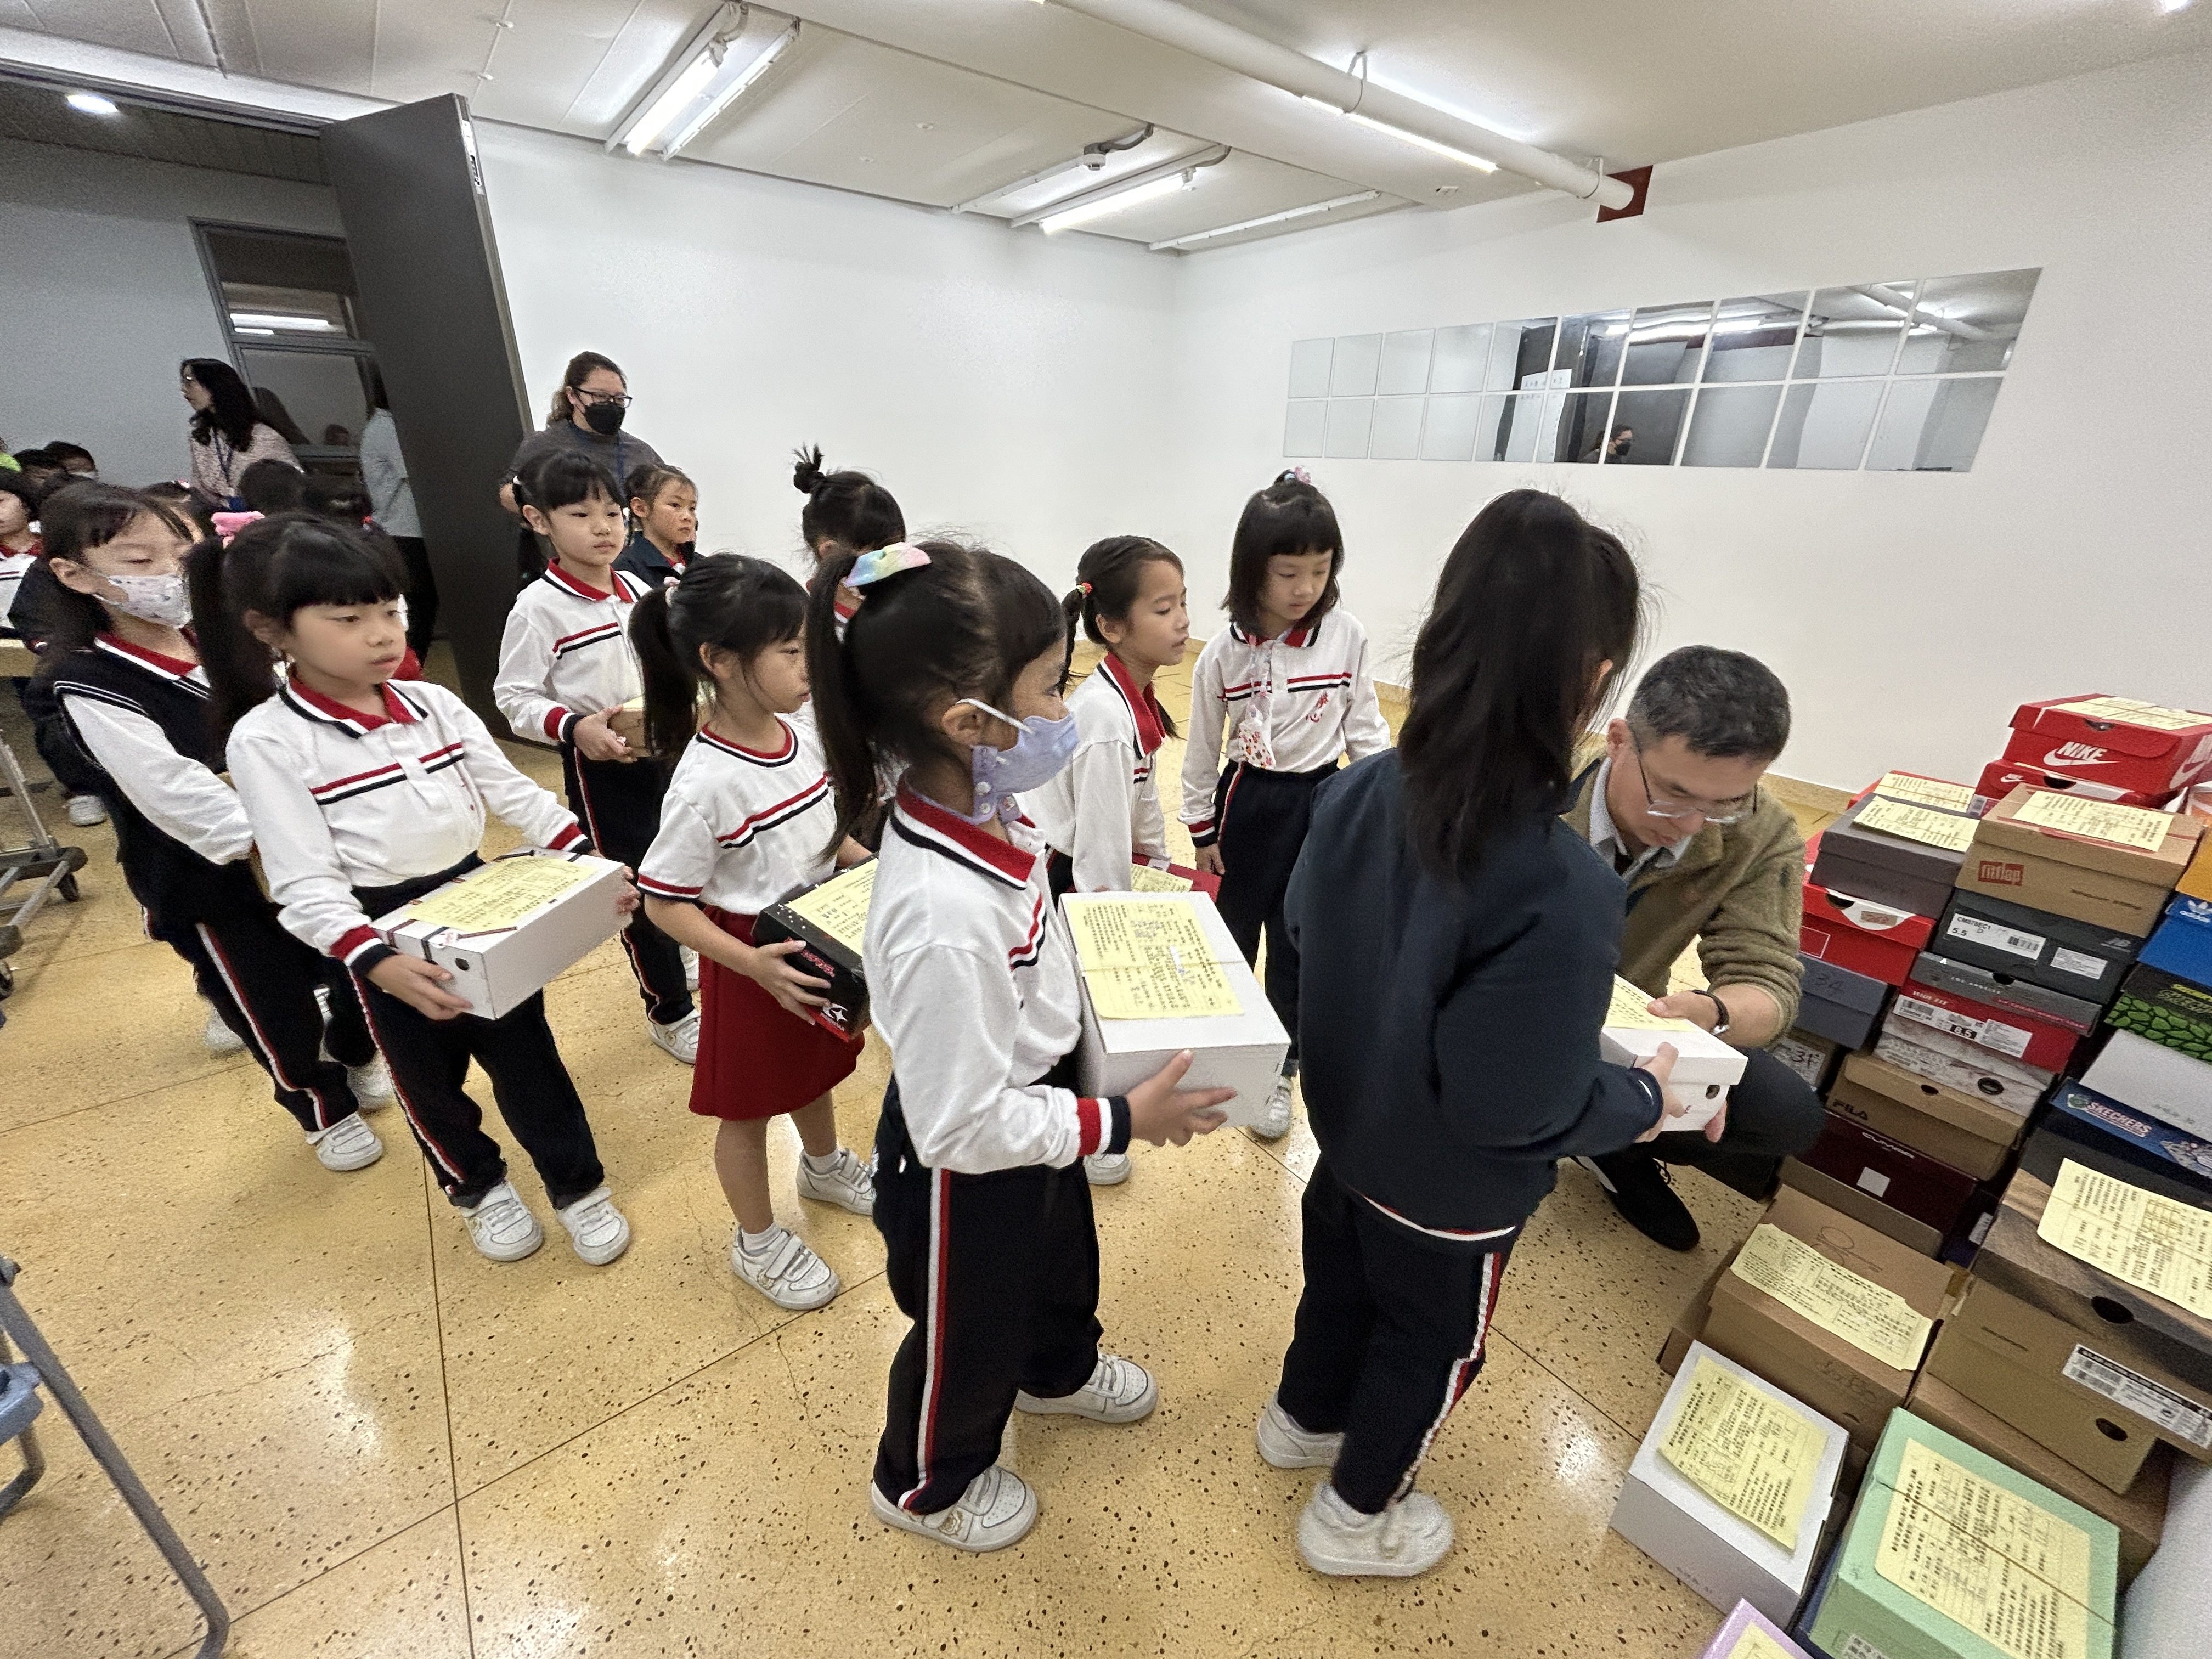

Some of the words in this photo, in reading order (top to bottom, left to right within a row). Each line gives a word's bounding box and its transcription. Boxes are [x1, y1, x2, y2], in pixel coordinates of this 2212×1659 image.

[2056, 741, 2108, 760] NIKE
[1951, 927, 1968, 936] 5.5
[1953, 1025, 1972, 1038] 8.5
[1833, 1099, 1868, 1120] FILA
[2087, 1101, 2153, 1134] SKECHERS
